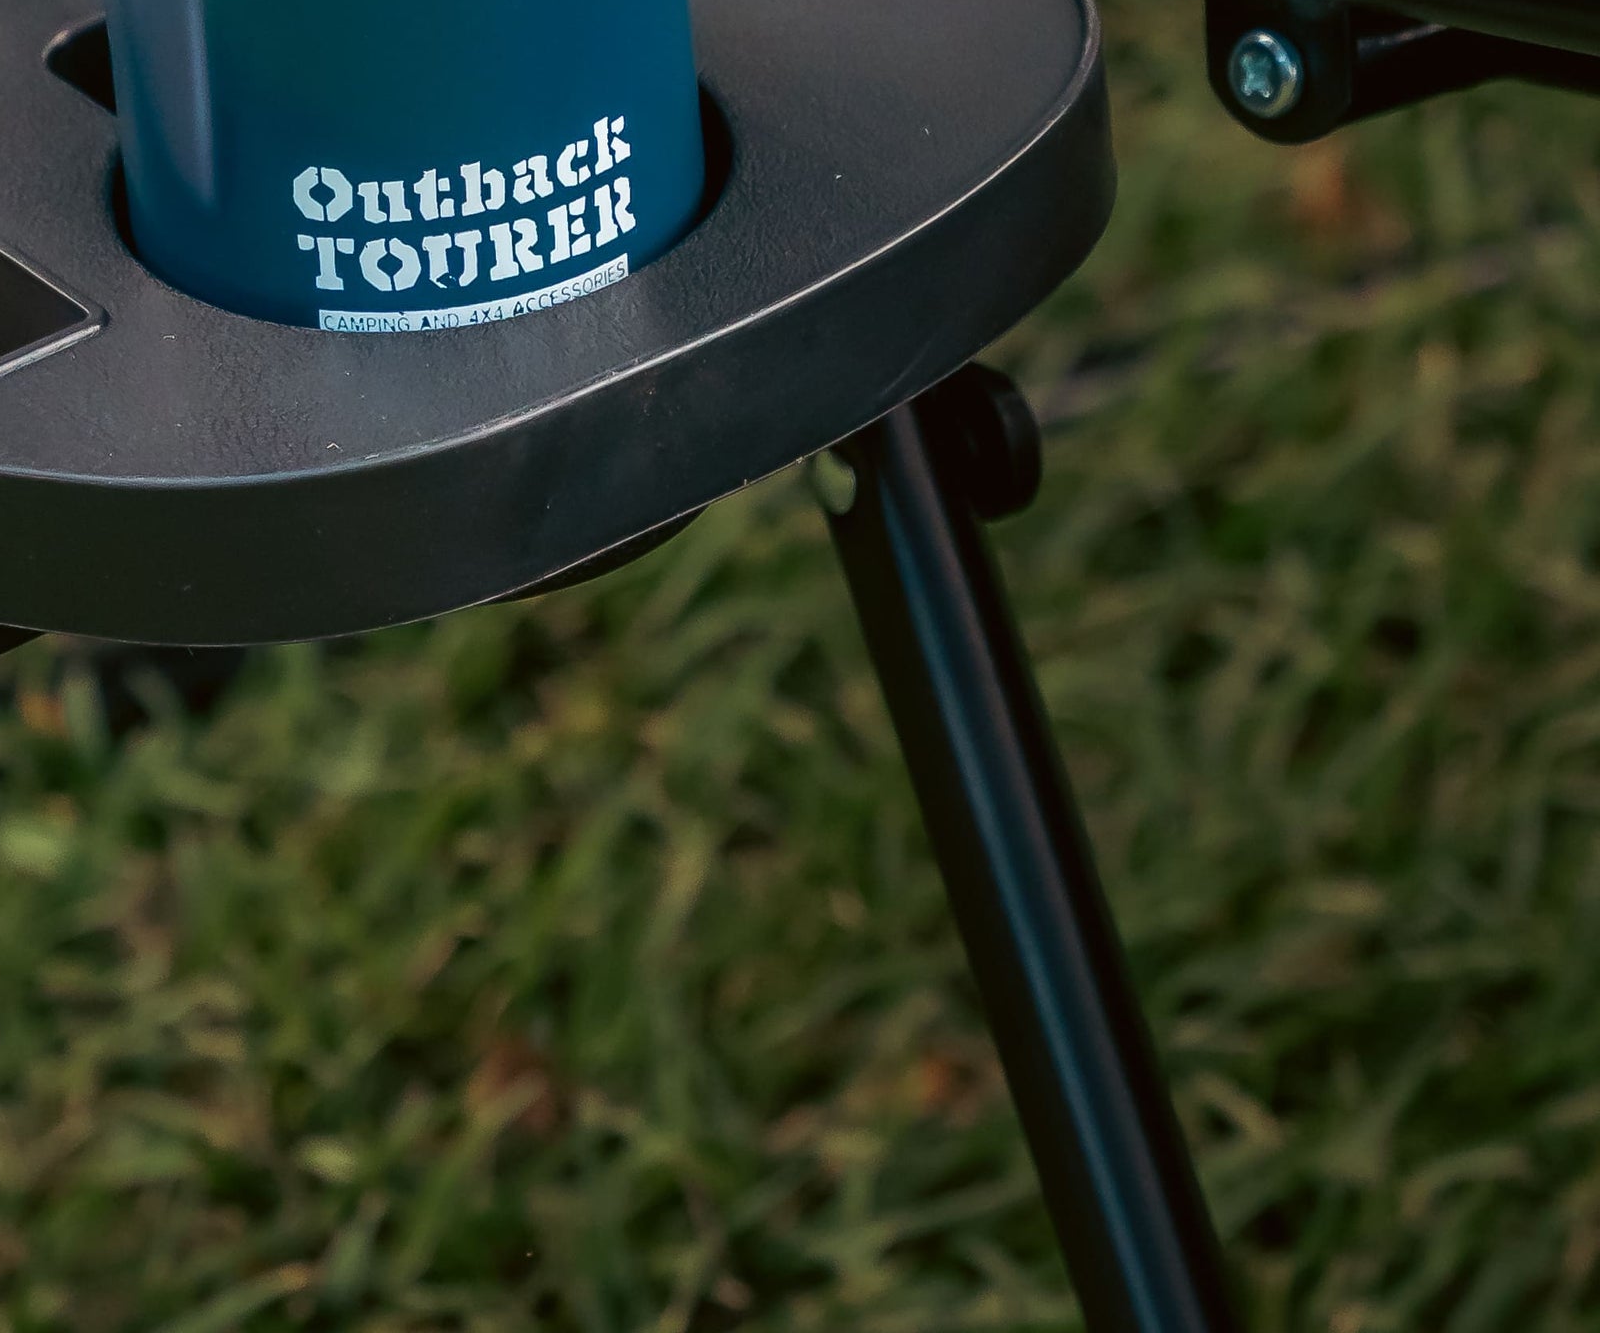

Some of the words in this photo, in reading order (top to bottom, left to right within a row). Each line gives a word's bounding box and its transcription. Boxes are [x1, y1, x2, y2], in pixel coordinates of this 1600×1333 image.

[293, 115, 631, 224] Outback
[297, 176, 636, 292] TOURER
[323, 311, 411, 332] CAMPING
[420, 313, 460, 332] AND
[511, 259, 627, 316] ACCESSORIES
